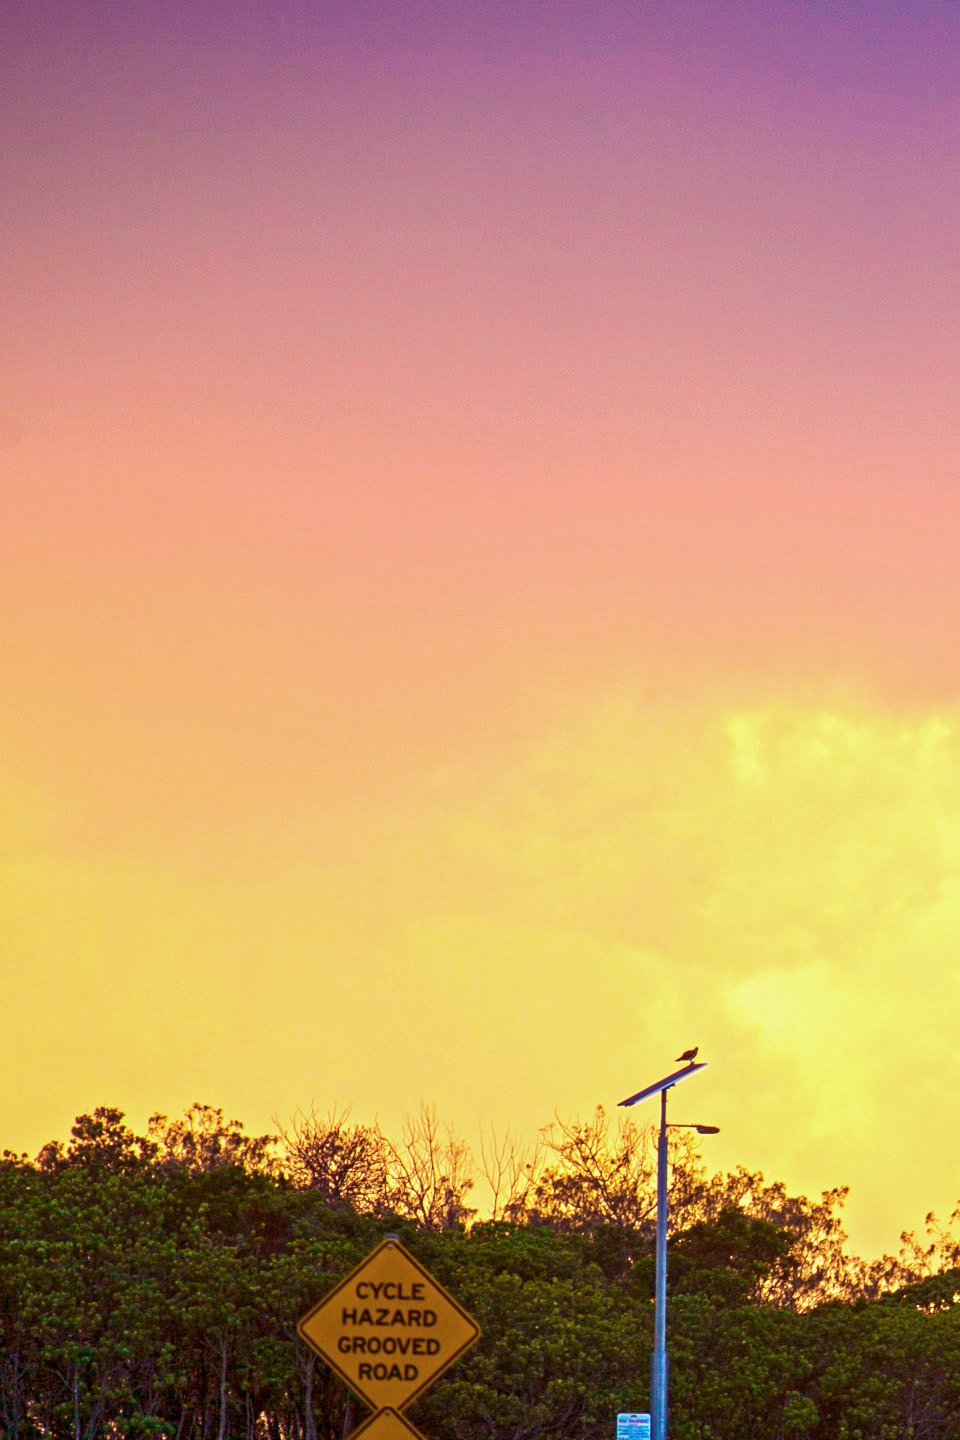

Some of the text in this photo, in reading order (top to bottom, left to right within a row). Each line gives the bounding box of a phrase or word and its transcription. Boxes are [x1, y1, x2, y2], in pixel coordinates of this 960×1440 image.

[355, 1281, 426, 1301] CYCLE
[341, 1308, 438, 1328] HAZARD
[337, 1336, 441, 1356] GROOVED
[358, 1363, 419, 1382] ROAD
